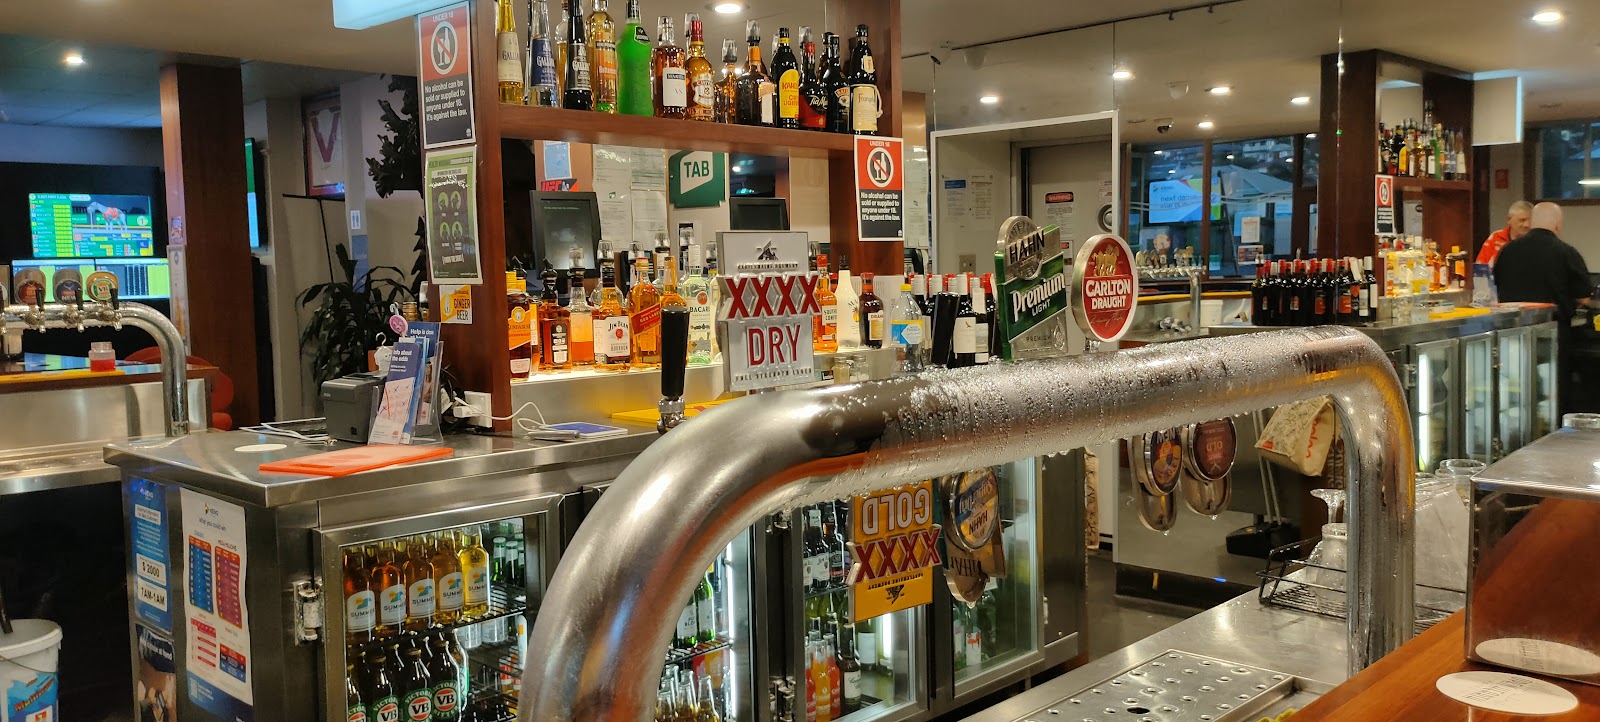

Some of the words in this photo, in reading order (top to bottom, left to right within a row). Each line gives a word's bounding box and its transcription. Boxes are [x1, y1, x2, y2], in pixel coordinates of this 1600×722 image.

[432, 13, 448, 22] UNDER
[424, 84, 431, 93] No
[432, 82, 448, 91] alcohol
[425, 94, 434, 103] sold
[441, 91, 460, 102] supplied
[426, 104, 441, 114] anyone
[442, 101, 455, 110] under
[433, 110, 450, 121] against
[458, 107, 467, 116] law.
[684, 161, 709, 178] TAB
[1009, 229, 1045, 264] HAHN
[1085, 279, 1130, 297] CARLTON
[454, 298, 470, 309] GINGER
[725, 275, 821, 319] XXXX
[1010, 273, 1066, 322] Premium
[1091, 295, 1126, 310] DRAUGHT
[1032, 299, 1051, 316] LIGHT
[457, 310, 469, 321] BEER
[748, 324, 801, 366] DRY
[756, 370, 789, 378] STRENGTH
[1206, 441, 1223, 452] OLD
[861, 488, 930, 535] GOLD
[969, 510, 988, 535] HAHN
[855, 528, 941, 584] XXXX
[142, 561, 146, 571] $
[147, 564, 160, 578] 2000
[141, 587, 165, 606] 7AM-1AM
[437, 694, 454, 705] VB
[381, 710, 397, 722] VB
[412, 703, 429, 714] VB
